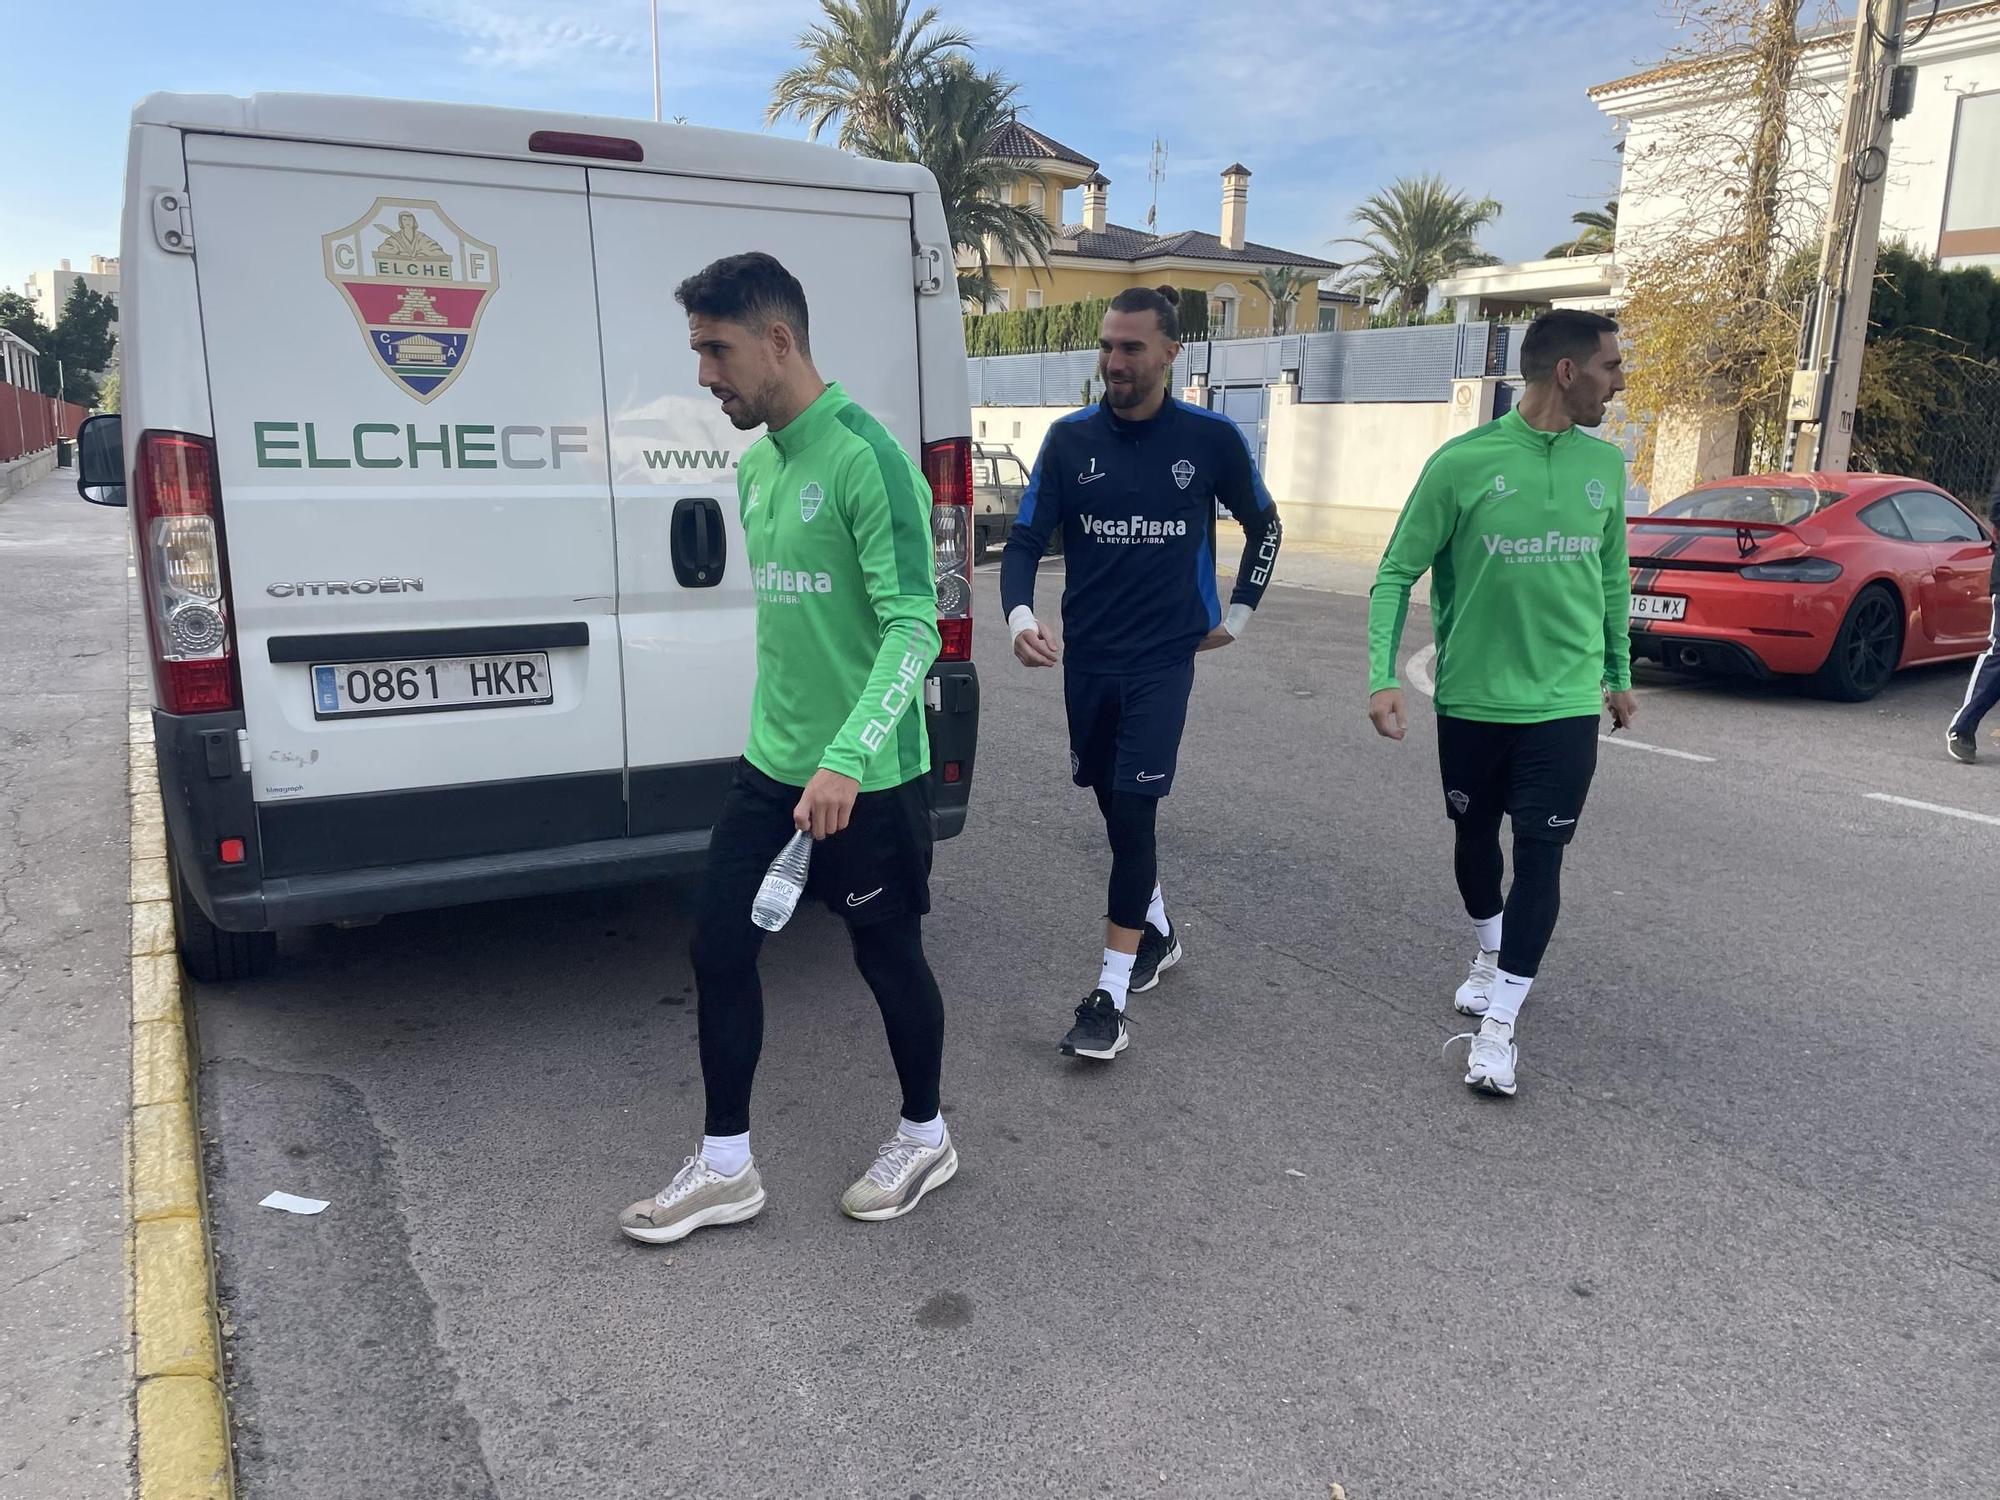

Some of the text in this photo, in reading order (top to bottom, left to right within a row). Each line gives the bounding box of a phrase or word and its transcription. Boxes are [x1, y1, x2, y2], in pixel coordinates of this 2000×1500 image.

[335, 243, 355, 269] C
[469, 253, 485, 279] F
[378, 261, 450, 278] ELCHE
[1090, 457, 1096, 473] 1
[1495, 475, 1505, 492] 6
[266, 576, 424, 598] CITROËN
[1631, 597, 1681, 615] 16 LWX
[346, 660, 539, 704] 0861 HKR
